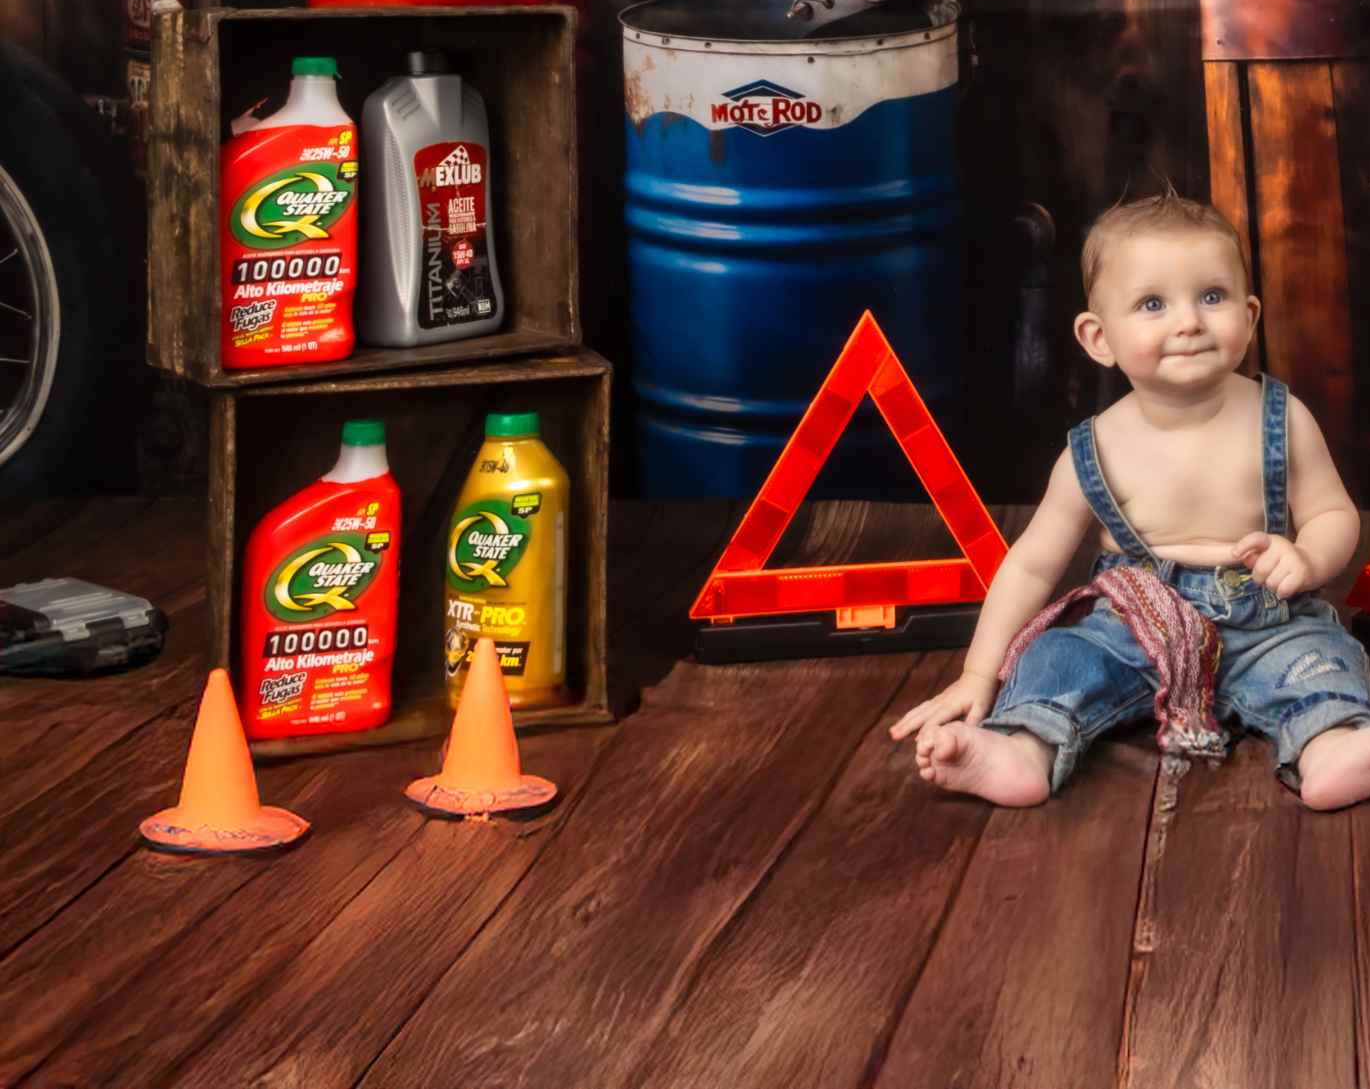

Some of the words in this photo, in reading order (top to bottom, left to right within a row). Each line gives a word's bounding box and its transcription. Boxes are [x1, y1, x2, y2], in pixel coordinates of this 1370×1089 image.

[277, 192, 348, 205] QUAKER
[283, 202, 336, 216] STATE
[237, 256, 340, 282] 100000
[426, 202, 442, 321] TITANIUM
[233, 284, 264, 299] Alto
[266, 278, 344, 296] Kilometraje
[231, 300, 276, 320] Reduce
[233, 313, 273, 331] Fugas
[468, 531, 523, 548] QUAKER
[473, 545, 511, 560] STATE
[309, 562, 375, 577] QUAKER
[313, 573, 358, 588] STATE
[269, 626, 368, 655] 100000
[264, 657, 294, 672] Alto
[296, 648, 375, 669] Kilometraje
[260, 671, 307, 694] Reduce
[262, 684, 302, 705] Fugas
